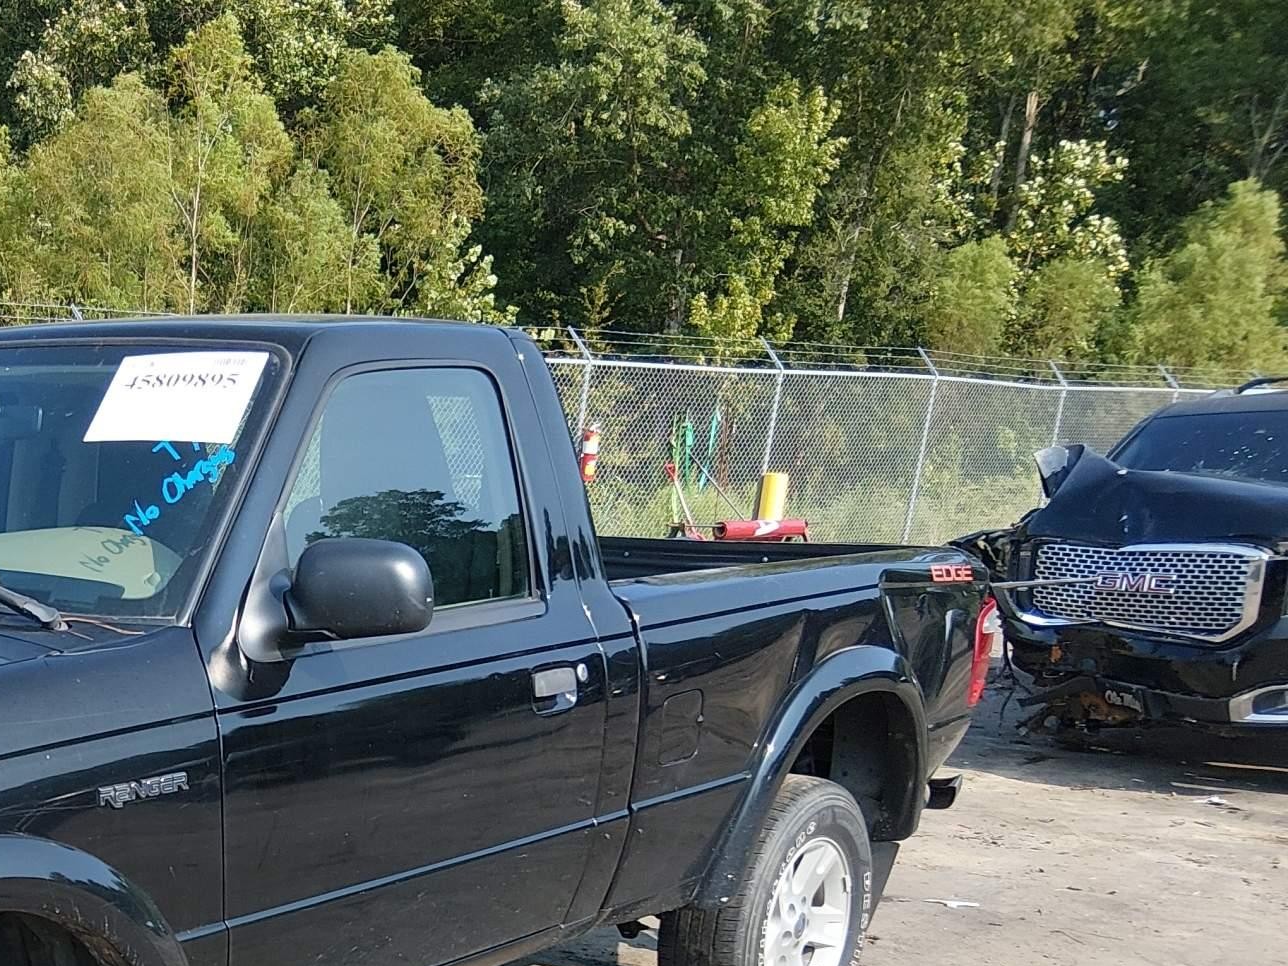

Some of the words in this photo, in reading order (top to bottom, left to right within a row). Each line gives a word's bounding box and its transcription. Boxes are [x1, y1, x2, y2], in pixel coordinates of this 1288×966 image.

[930, 564, 973, 582] EDGE
[1094, 572, 1177, 594] GMC
[98, 771, 190, 809] RANGER
